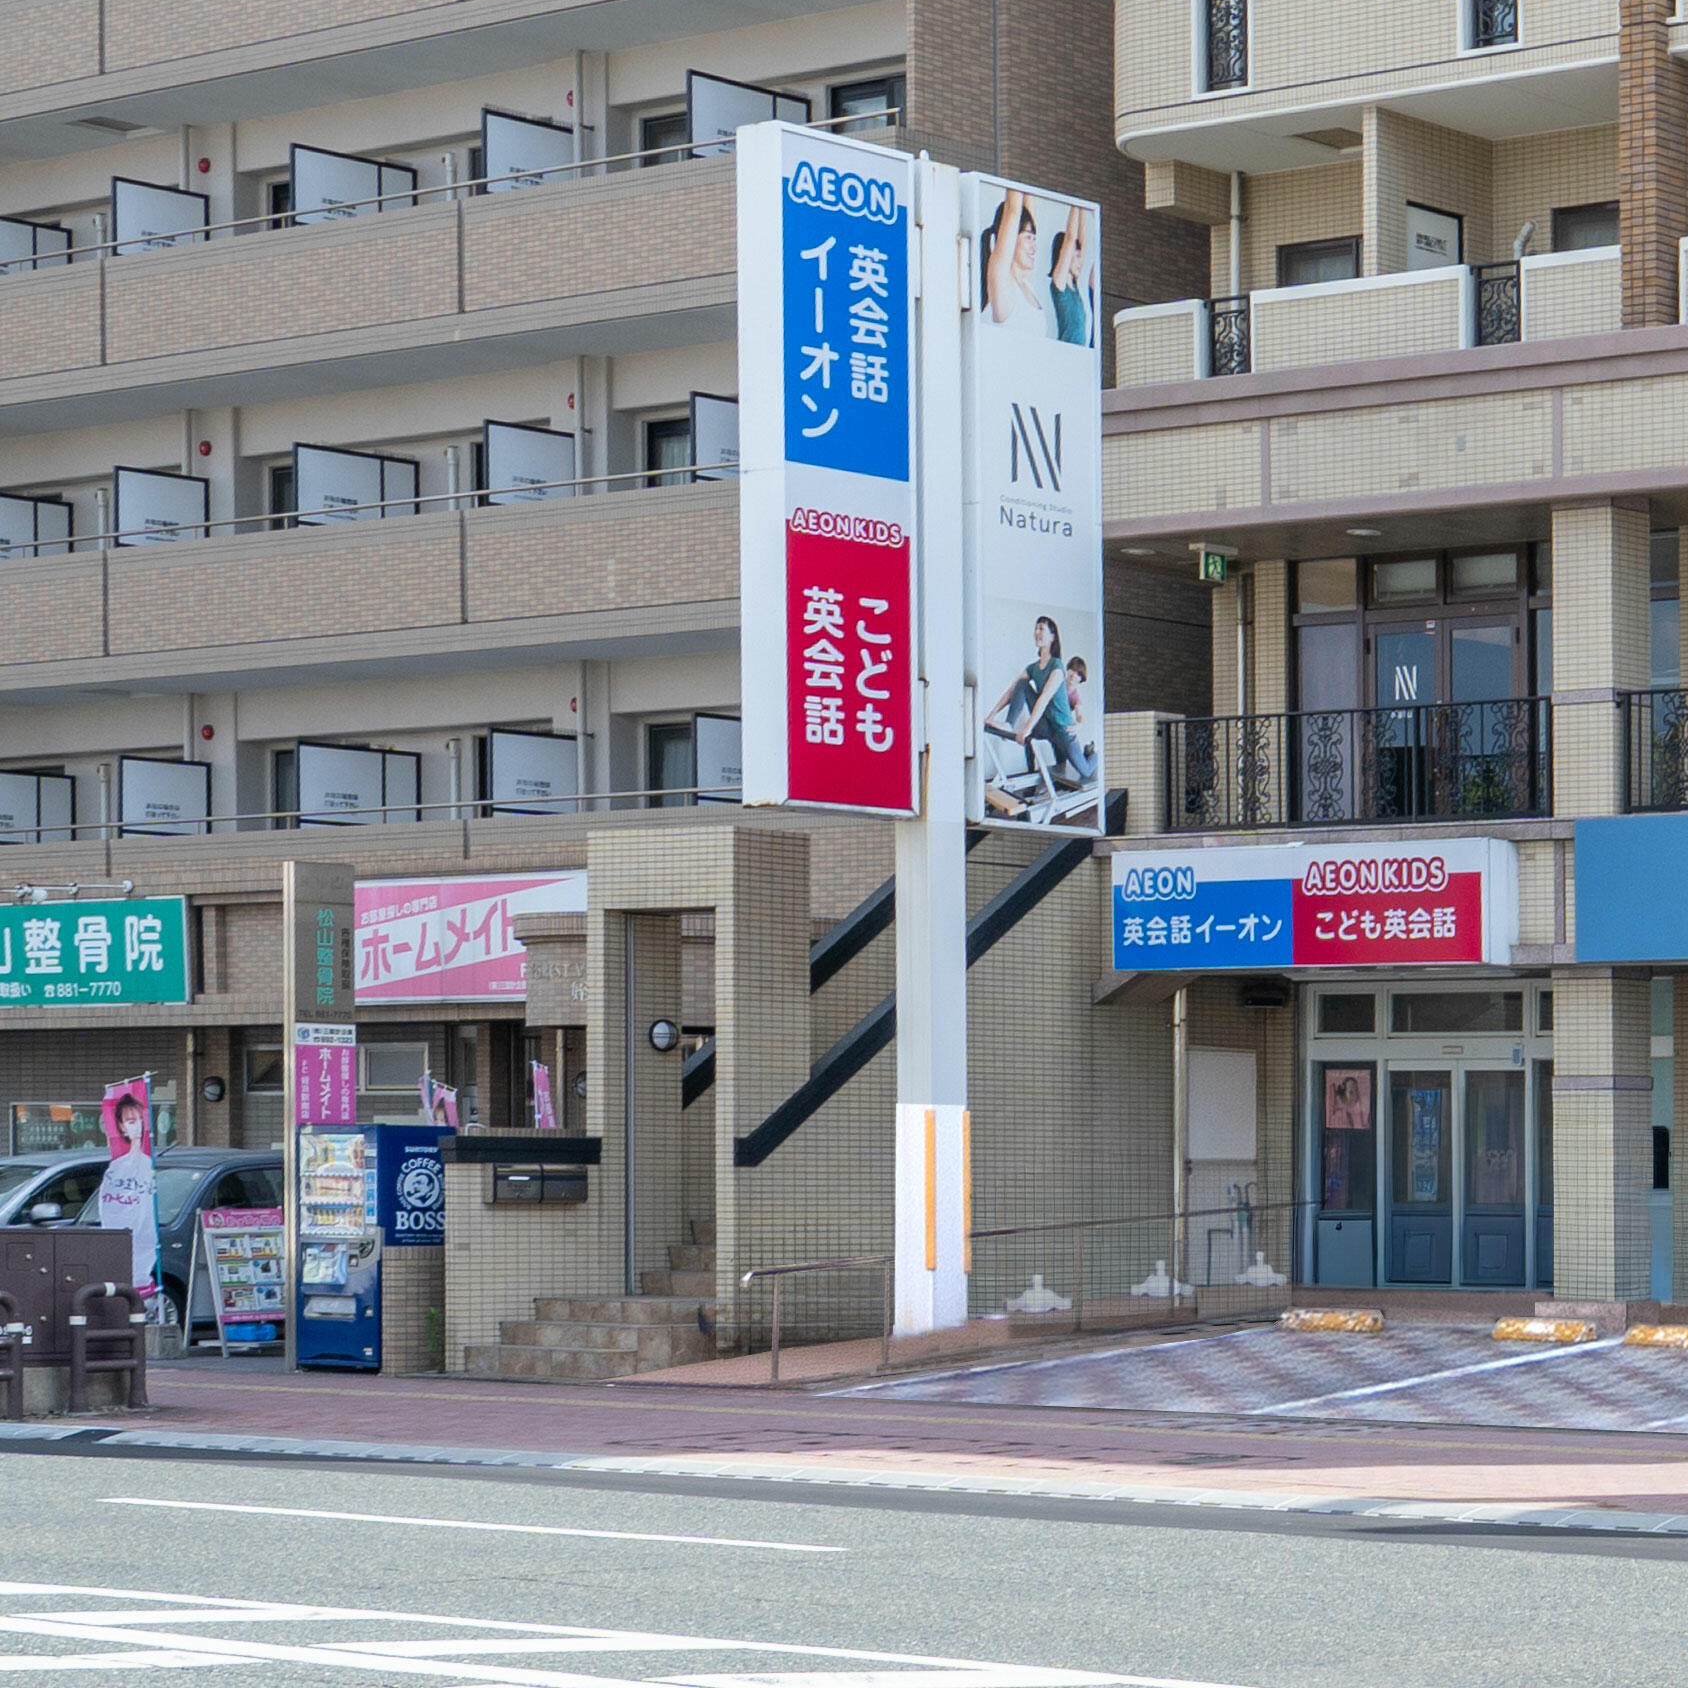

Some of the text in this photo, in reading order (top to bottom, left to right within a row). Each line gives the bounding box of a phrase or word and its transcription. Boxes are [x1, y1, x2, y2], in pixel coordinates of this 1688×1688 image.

[795, 161, 896, 216] AEON
[800, 235, 839, 438] イーオン
[848, 244, 890, 404] 英会話
[792, 511, 903, 546] AEON KIDS
[1000, 505, 1072, 537] Natura
[803, 586, 845, 747] 英会話
[856, 597, 895, 753] こども
[1125, 868, 1193, 897] AEON
[1306, 860, 1445, 889] AEON KIDS
[361, 898, 514, 981] ホームメイト
[1122, 914, 1283, 947] 英会話イーオン
[1315, 906, 1457, 940] こども英会話
[316, 908, 335, 1005] 松山整骨院
[319, 1048, 332, 1120] ホームメイト
[401, 1157, 442, 1174] COFFEE
[395, 1211, 446, 1230] BOSS
